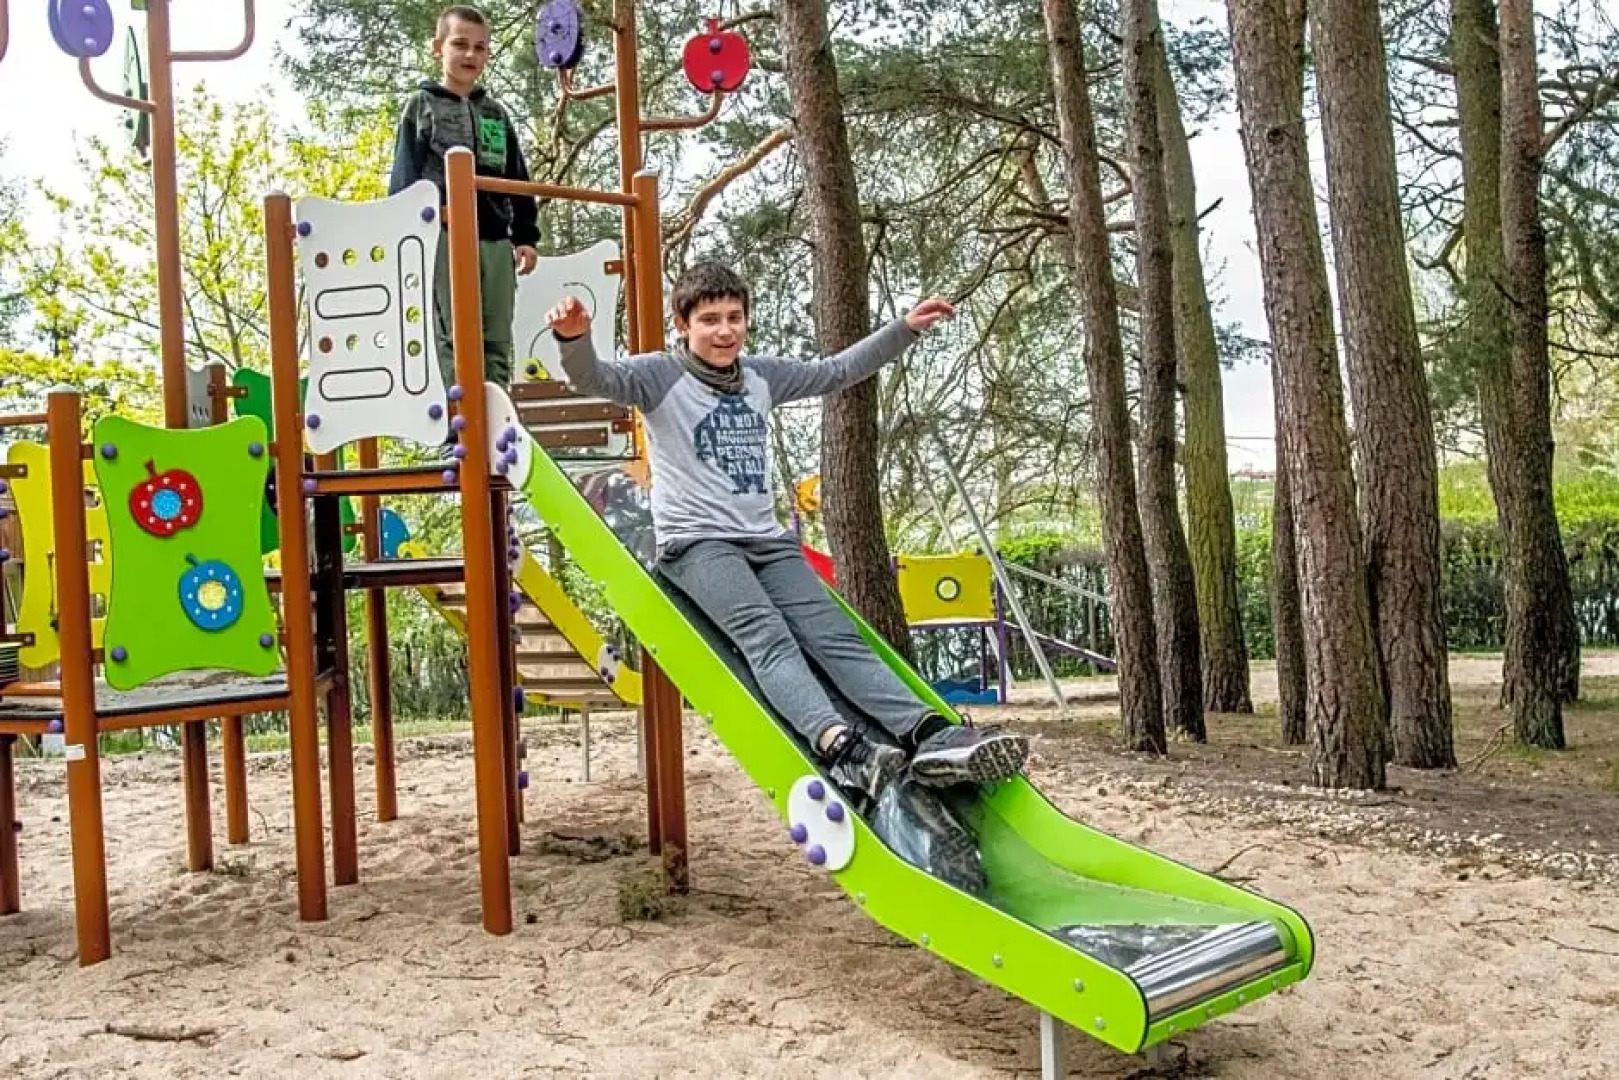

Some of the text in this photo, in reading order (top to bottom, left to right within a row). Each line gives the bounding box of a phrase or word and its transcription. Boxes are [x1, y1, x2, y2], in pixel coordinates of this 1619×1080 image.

[733, 414, 757, 428] NOT
[716, 430, 764, 445] MORN
[728, 460, 763, 475] AT ALL
